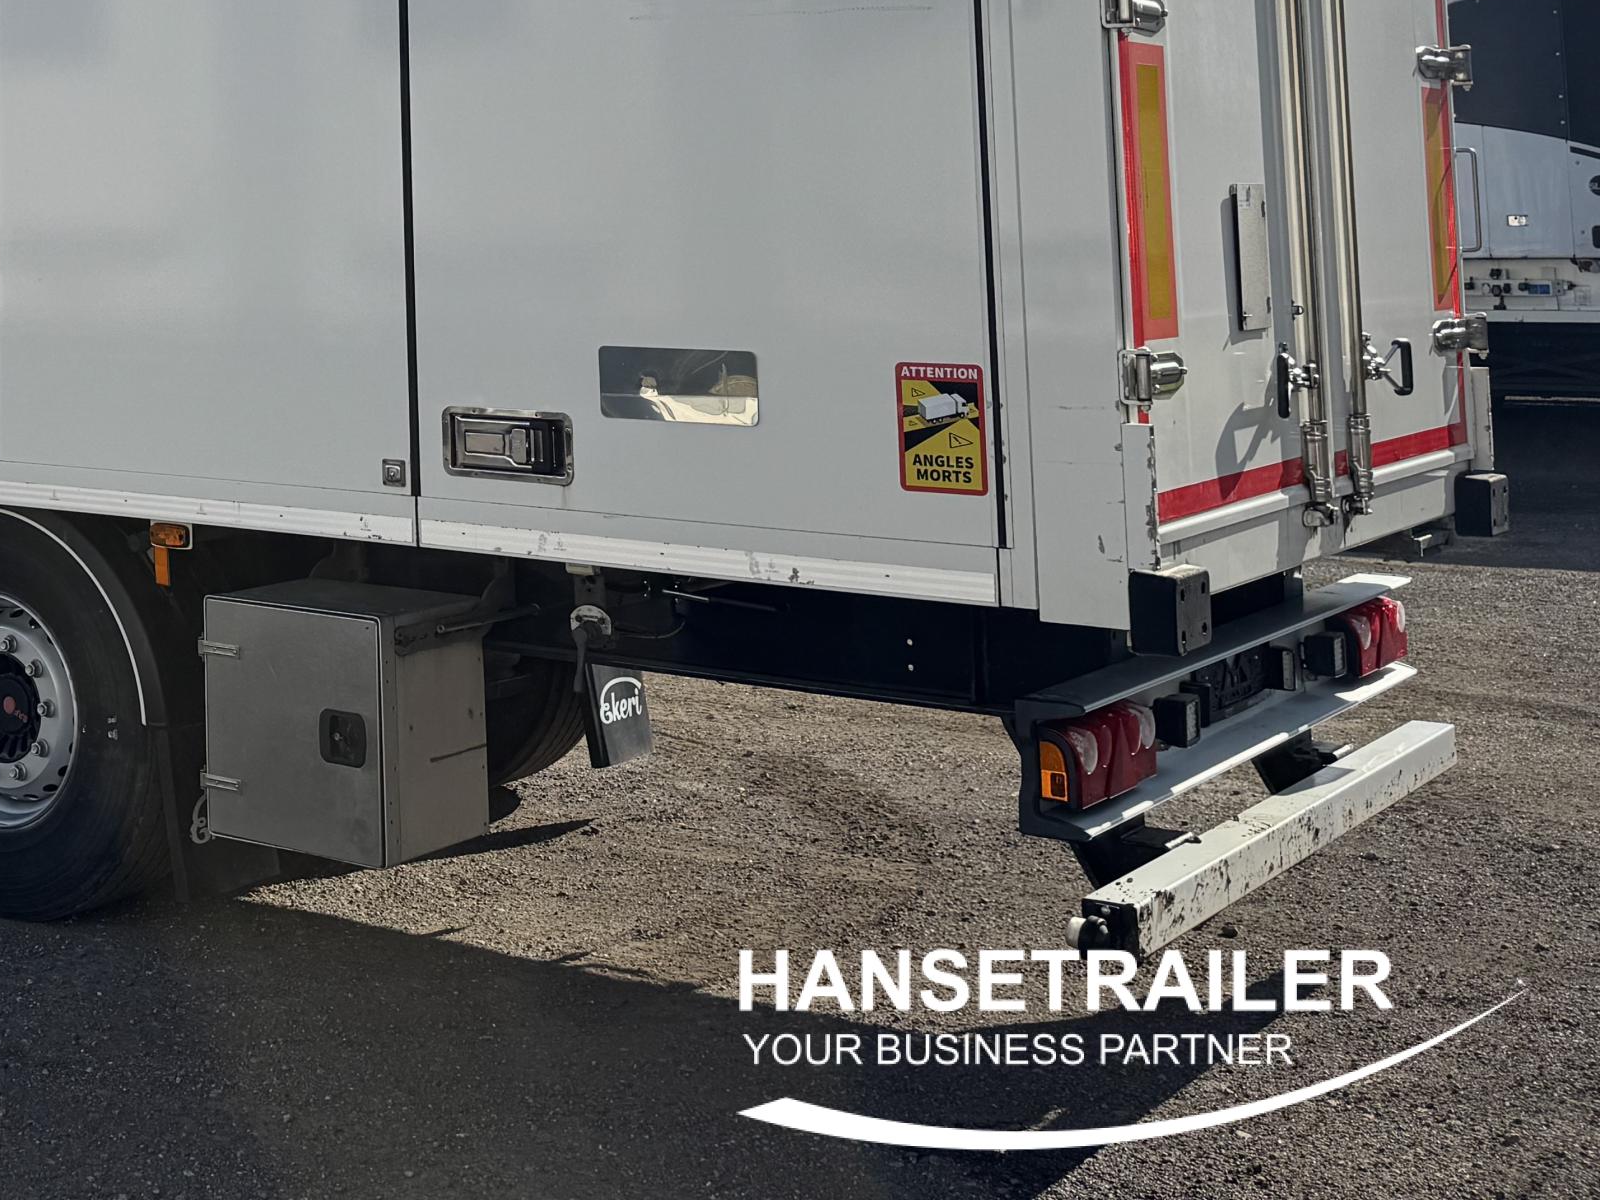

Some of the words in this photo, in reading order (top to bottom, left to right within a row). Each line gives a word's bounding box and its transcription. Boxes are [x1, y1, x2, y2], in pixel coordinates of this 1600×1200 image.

[901, 366, 978, 380] ATTENTION
[913, 454, 974, 469] ANGLES
[916, 469, 972, 484] MORTS
